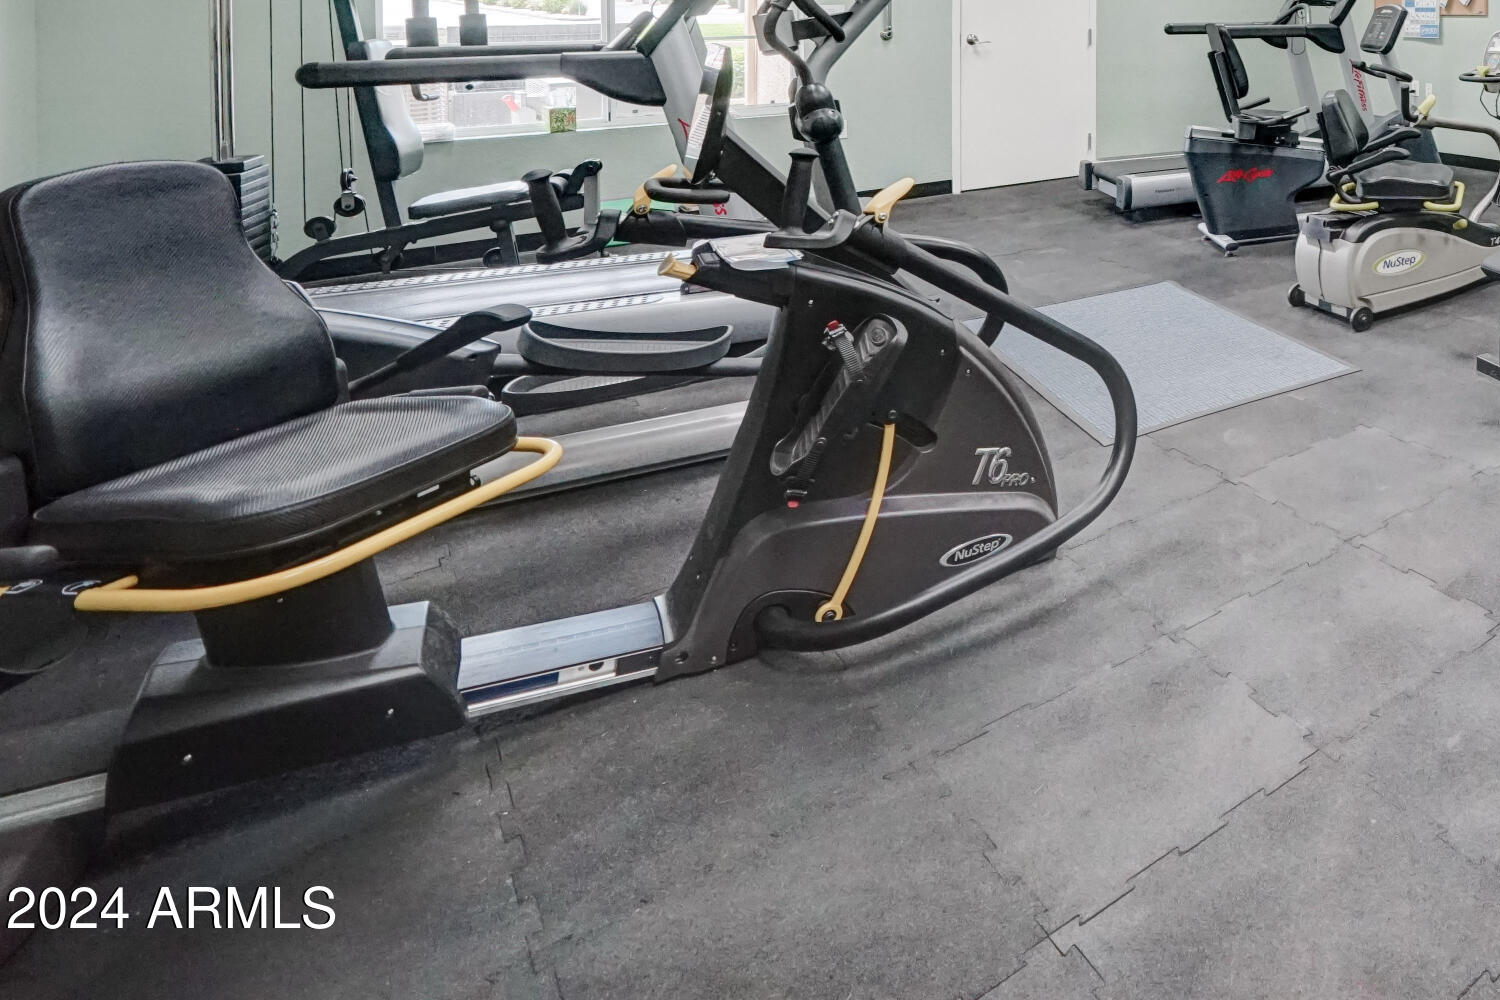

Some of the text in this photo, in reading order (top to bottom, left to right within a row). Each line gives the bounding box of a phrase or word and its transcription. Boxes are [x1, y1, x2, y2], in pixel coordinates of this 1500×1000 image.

[1383, 256, 1416, 269] NuStep
[971, 446, 1012, 486] T6
[954, 540, 1000, 562] NuStep
